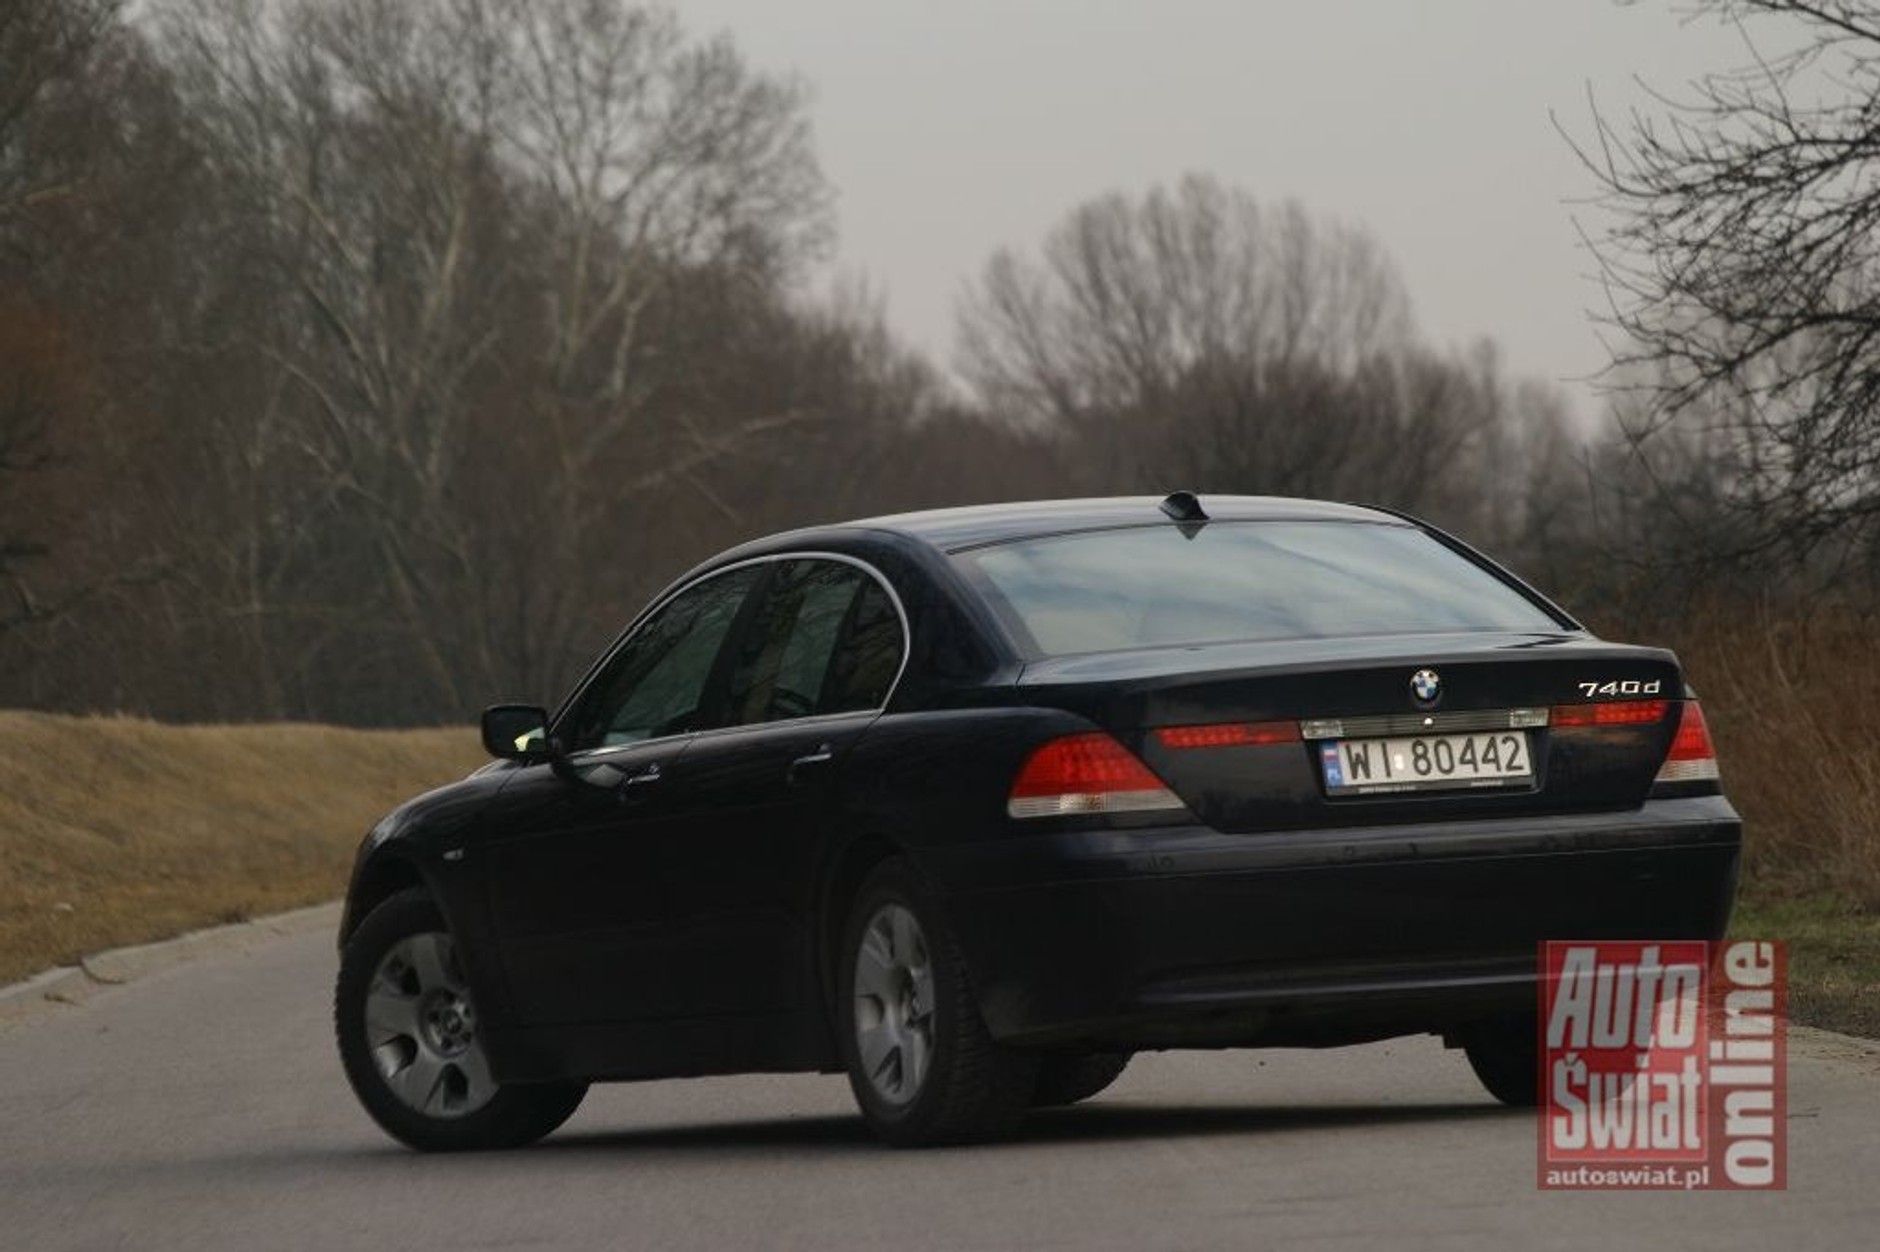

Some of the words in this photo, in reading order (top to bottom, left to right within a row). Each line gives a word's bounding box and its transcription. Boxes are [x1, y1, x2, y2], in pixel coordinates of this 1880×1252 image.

[1579, 680, 1660, 697] 740d
[1345, 742, 1391, 779] WI
[1411, 736, 1524, 776] 80442
